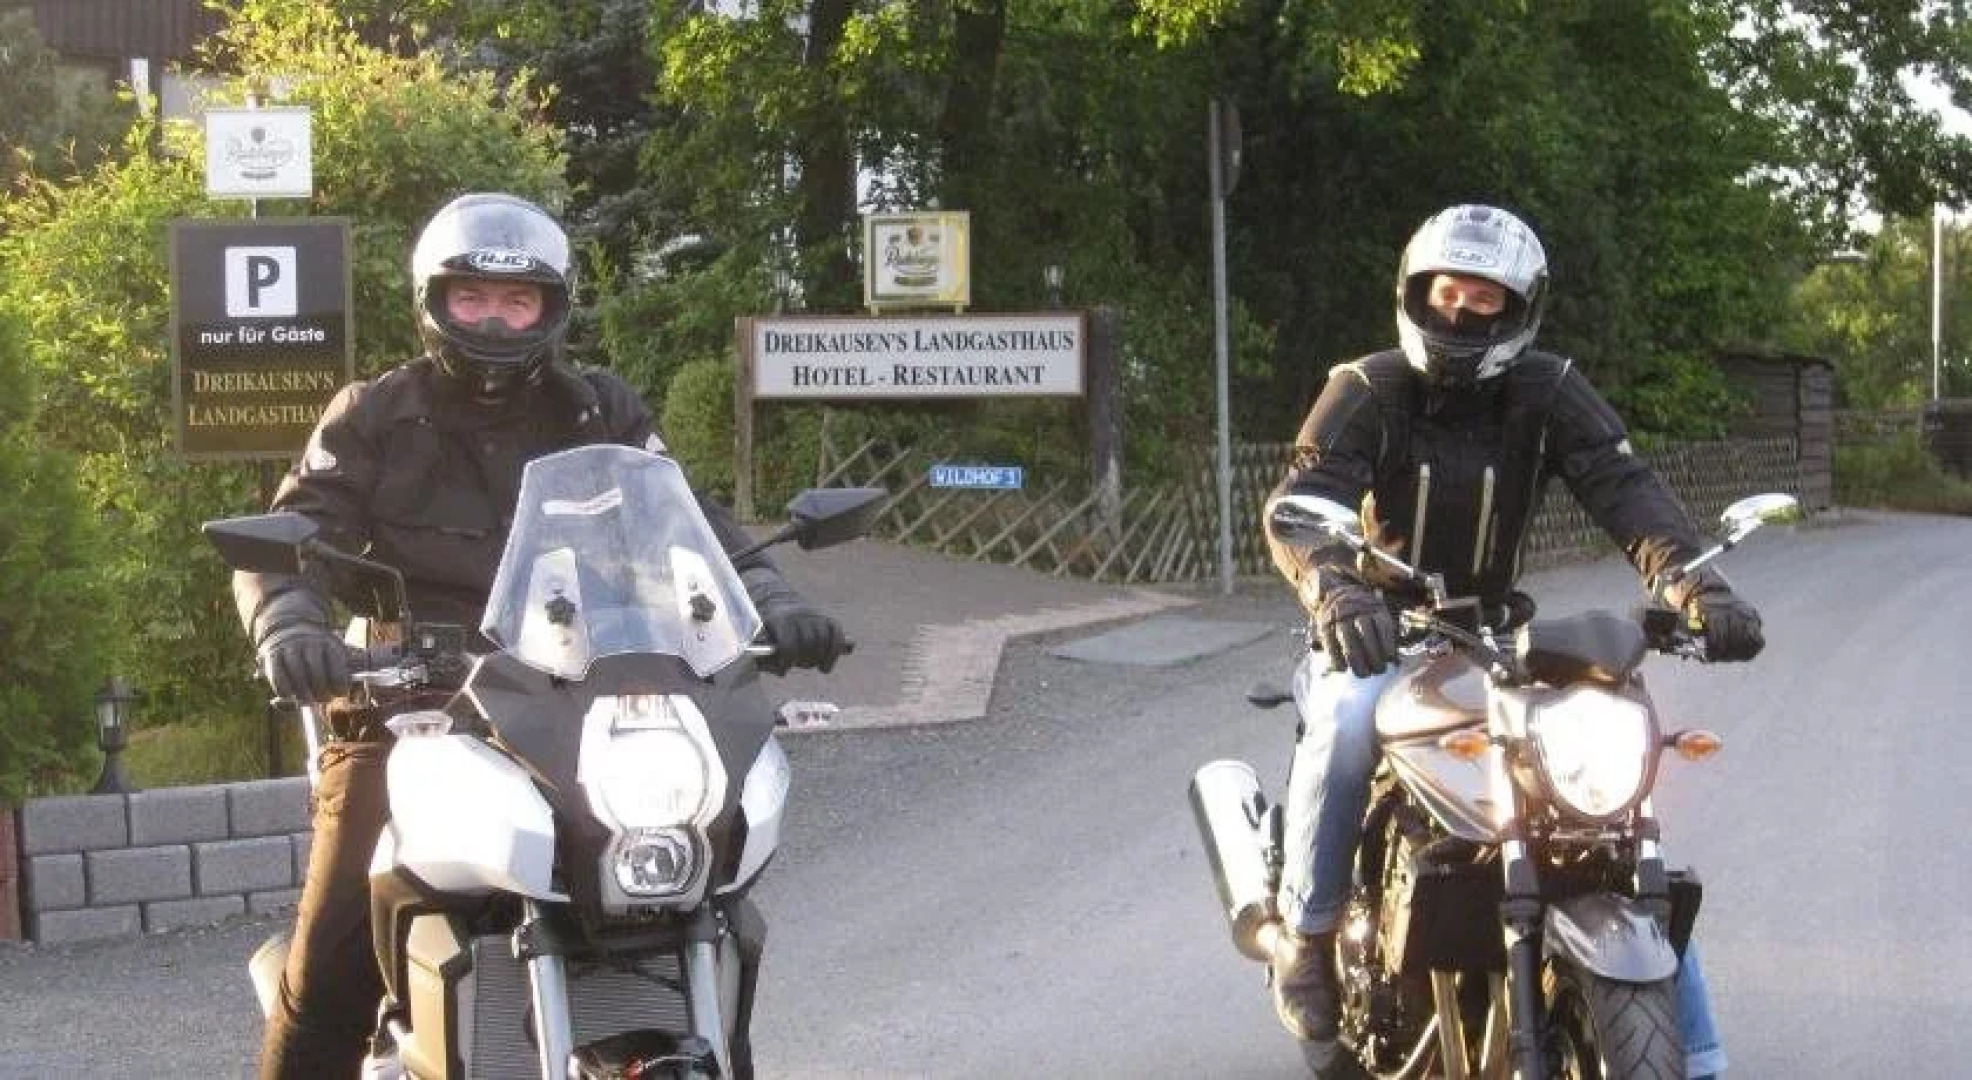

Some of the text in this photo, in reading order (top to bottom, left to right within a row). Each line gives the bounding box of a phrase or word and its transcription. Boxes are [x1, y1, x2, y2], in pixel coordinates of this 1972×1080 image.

[246, 256, 280, 308] P
[201, 325, 326, 344] nur für Gäste
[764, 329, 1075, 353] DREIKAUSEN'S LANDGASTHAUS
[194, 369, 335, 393] DREIKAUSEN'S
[793, 365, 874, 386] HOTEL
[893, 364, 1046, 386] RESTAURANT
[187, 403, 324, 426] LANDGASTHA
